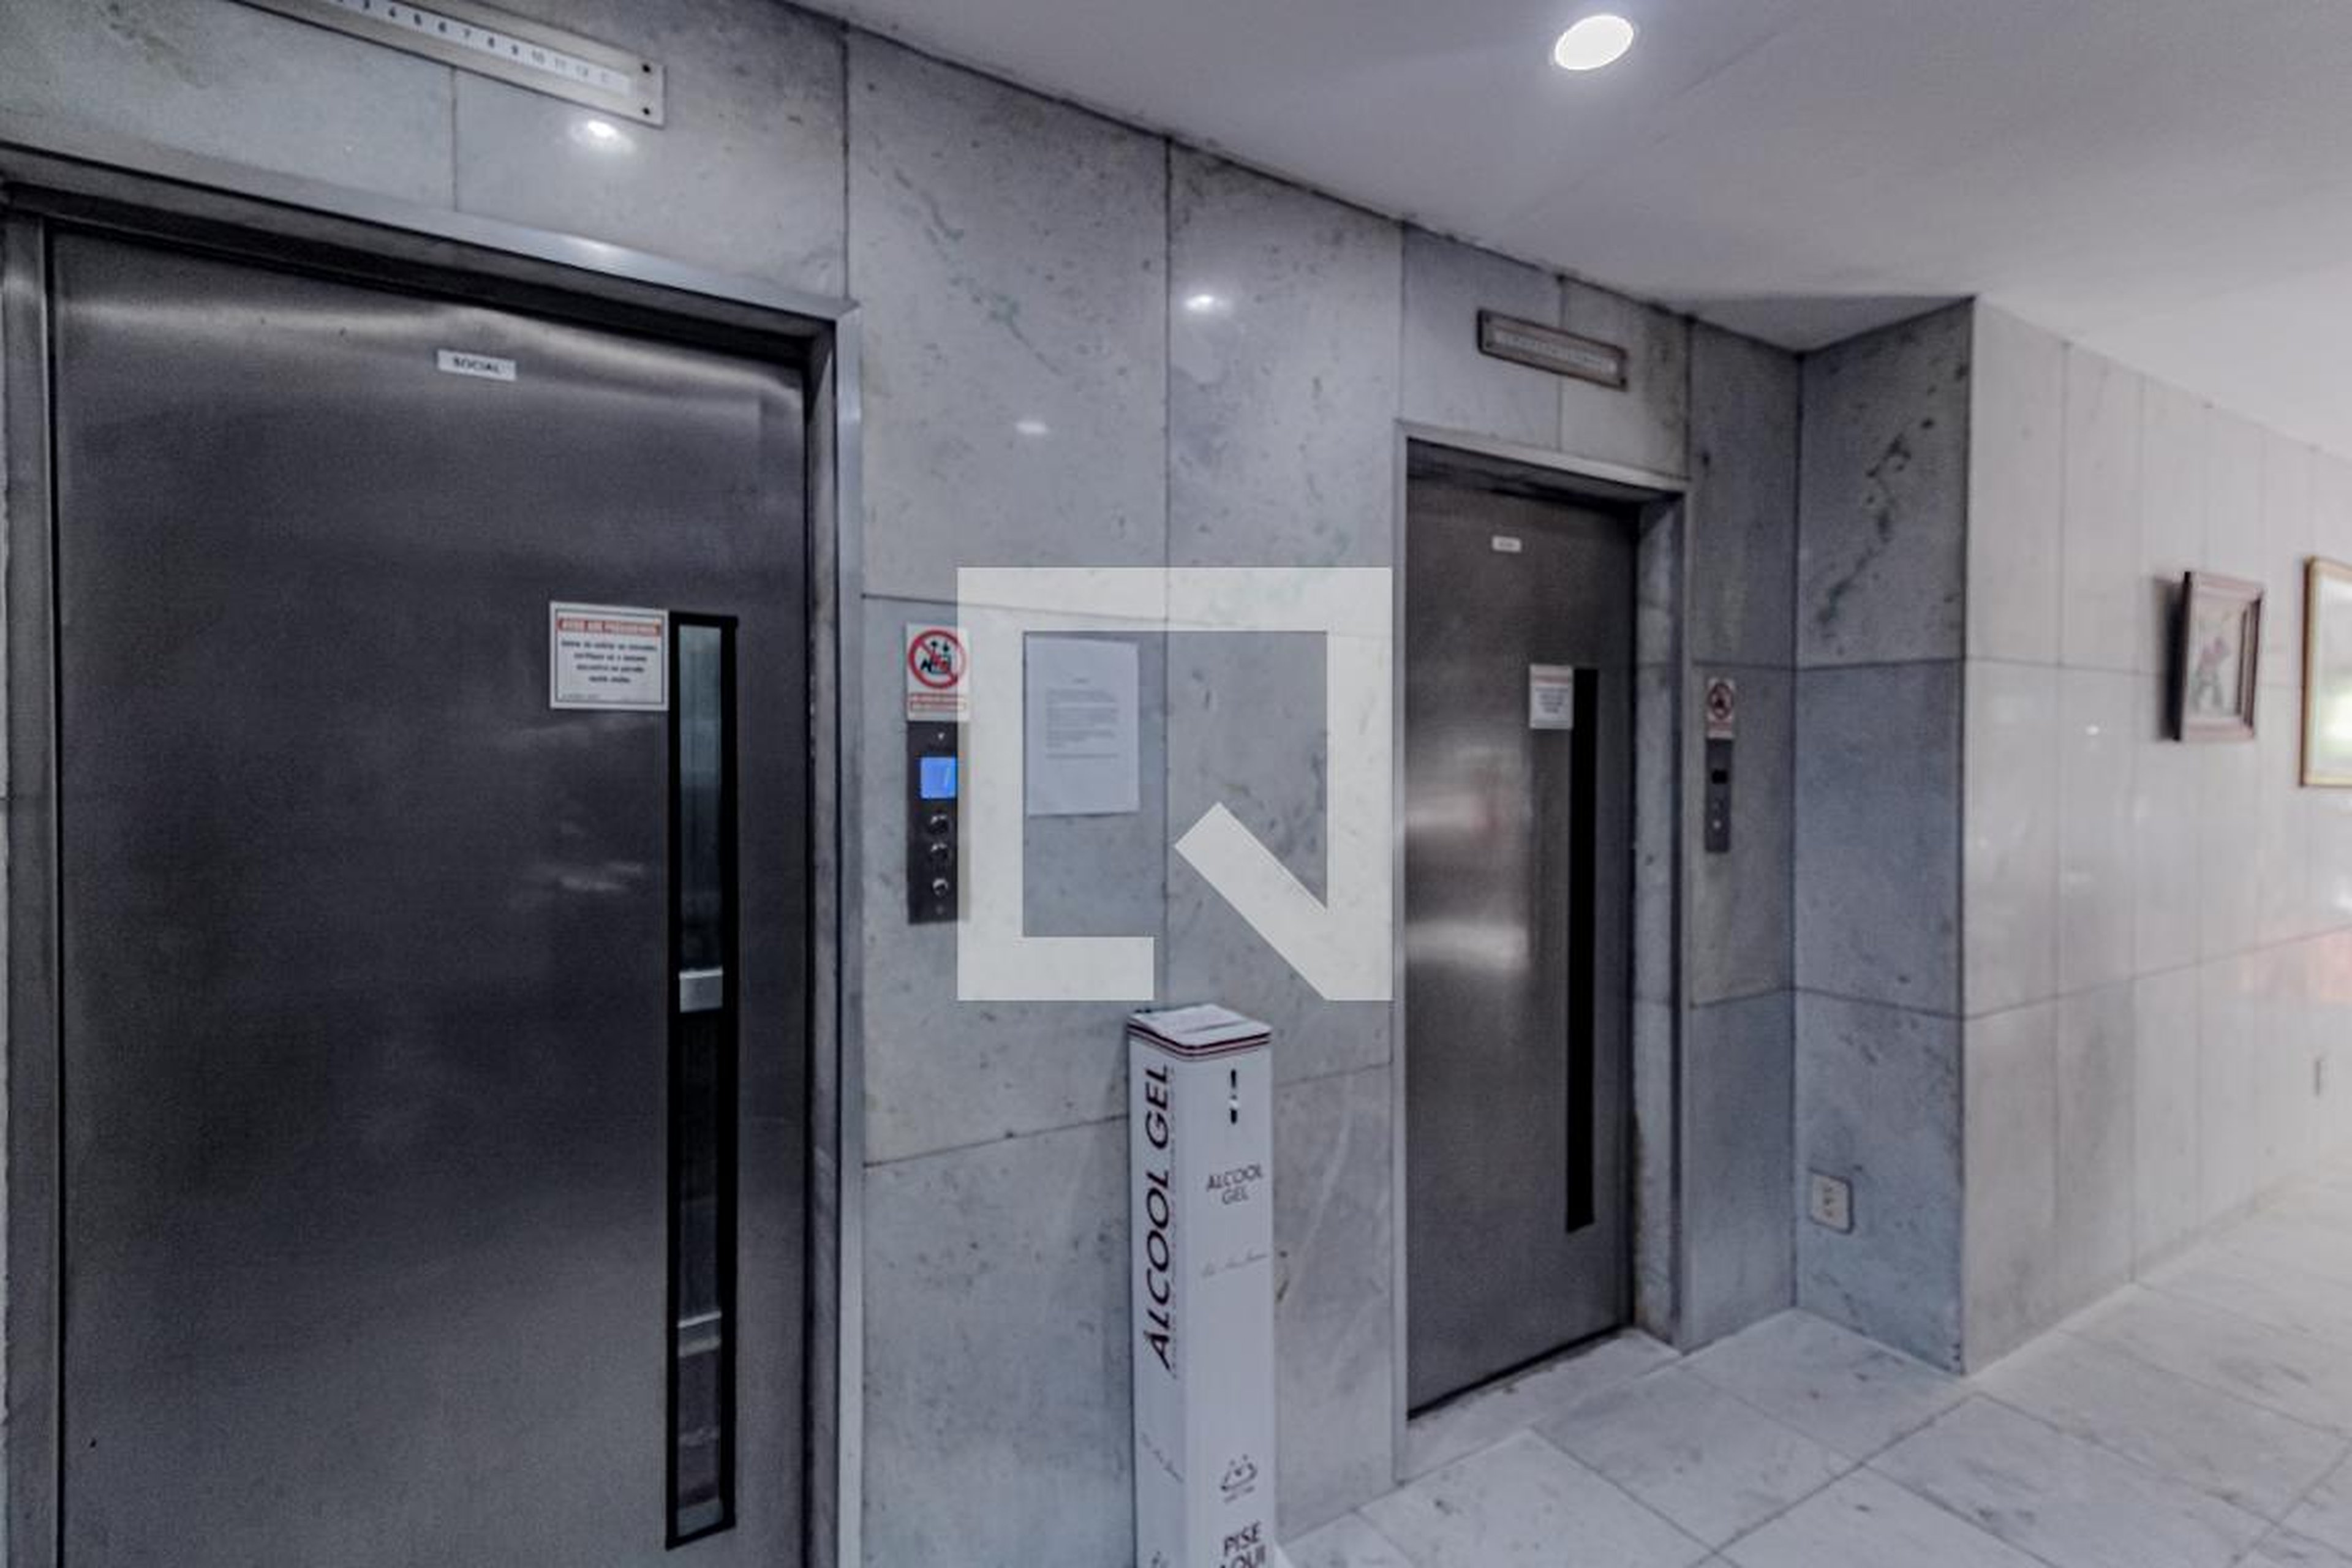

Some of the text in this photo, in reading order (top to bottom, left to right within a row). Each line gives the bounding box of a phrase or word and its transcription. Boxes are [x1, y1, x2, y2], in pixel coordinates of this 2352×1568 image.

[1206, 1164, 1262, 1192] ALCOOL
[1222, 1188, 1249, 1205] GEL
[1144, 1064, 1170, 1372] ALCOOL GEL
[1224, 1519, 1261, 1556] PISE
[1220, 1544, 1265, 1568] QUI
